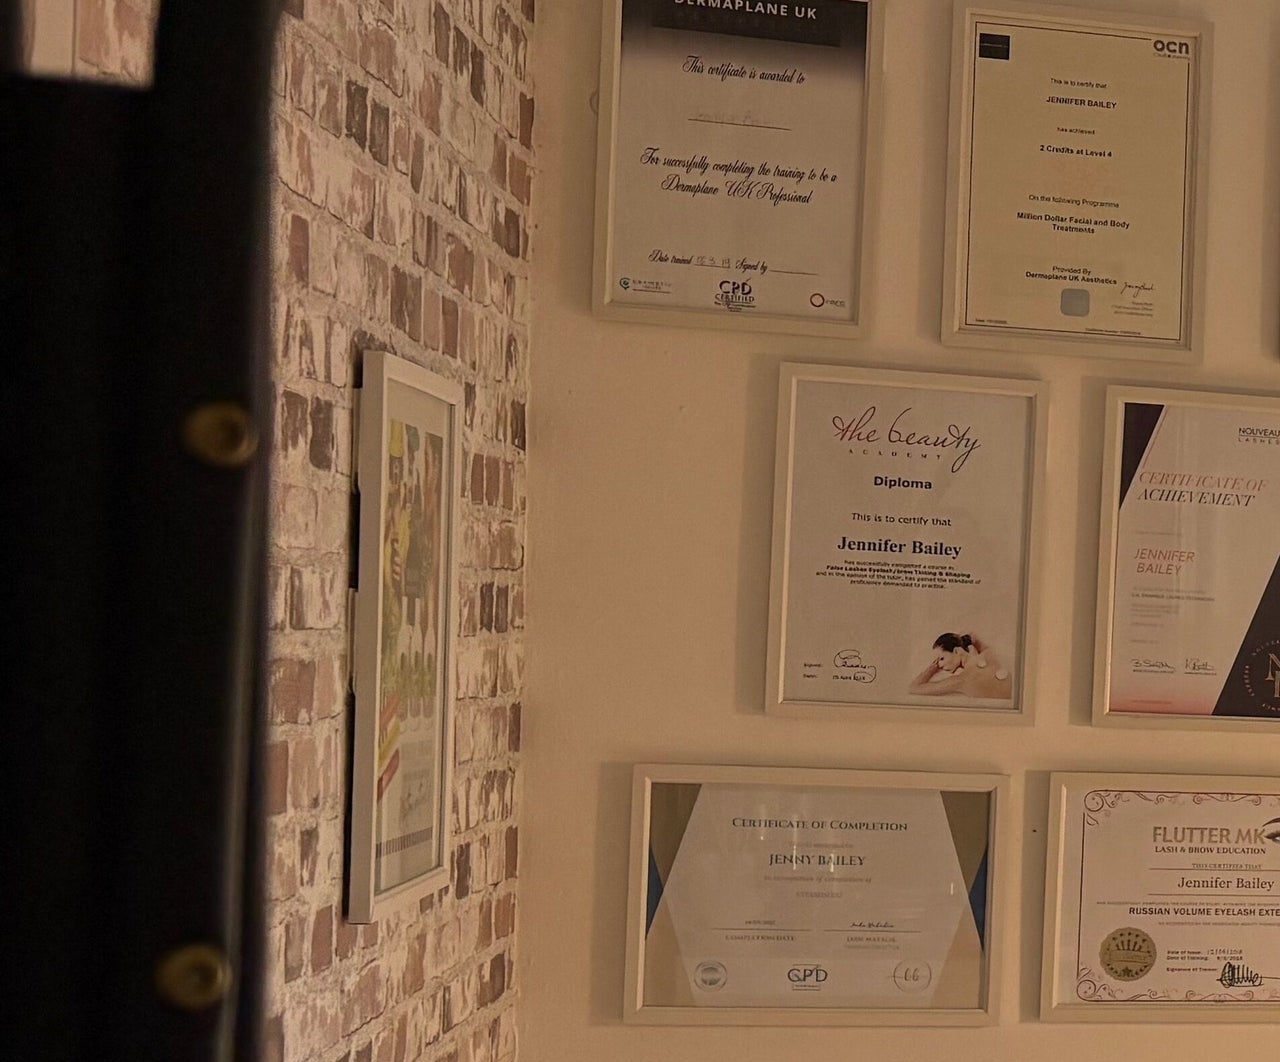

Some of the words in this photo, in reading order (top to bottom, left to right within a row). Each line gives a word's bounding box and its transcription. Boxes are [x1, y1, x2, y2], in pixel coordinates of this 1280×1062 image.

[675, 0, 788, 16] RMAPLANE
[795, 6, 816, 19] UK
[1153, 39, 1189, 54] ocn
[682, 55, 704, 75] This
[708, 63, 746, 85] certificate
[749, 68, 756, 79] is
[759, 68, 793, 83] awarded
[796, 72, 805, 84] to
[1046, 96, 1085, 107] JENNIFER
[1087, 100, 1116, 109] BAILEY
[1047, 145, 1074, 155] Credits
[1086, 149, 1105, 158] Level
[640, 147, 659, 165] For
[663, 154, 709, 174] successfully
[712, 160, 755, 179] completing
[758, 162, 771, 177] the
[773, 164, 806, 184] training
[808, 168, 816, 180] to
[820, 168, 829, 181] be
[661, 174, 719, 196] Dermaplane
[725, 180, 758, 199] UK
[757, 186, 813, 206] Professional
[1082, 198, 1119, 208] Programme
[1017, 212, 1042, 221] Million
[1045, 214, 1067, 223] Dollar
[1070, 217, 1092, 225] Facial
[1110, 220, 1130, 229] Body
[1052, 224, 1095, 234] Treatments
[649, 249, 669, 263] Date
[1026, 271, 1067, 281] Dermaplane
[719, 278, 752, 295] CPD
[832, 406, 880, 443] the
[888, 407, 981, 473] beauty
[874, 476, 932, 490] Diploma
[1139, 471, 1242, 489] CERTIFICATE
[1246, 479, 1270, 491] OF
[1137, 488, 1255, 507] ACHIEVEMENT
[852, 512, 871, 522] This
[886, 515, 895, 523] to
[898, 515, 928, 527] certify
[932, 517, 951, 527] that
[838, 536, 906, 554] Jennifer
[912, 540, 961, 560] Bailey
[1135, 549, 1195, 562] JENNIFER
[1137, 563, 1181, 576] BAILEY
[732, 817, 809, 830] CERTIFICATE
[812, 820, 827, 830] OF
[830, 820, 908, 832] COMPLETION
[1153, 826, 1231, 844] FLUTTER
[1235, 827, 1266, 845] MK
[1155, 846, 1177, 854] LASH
[1180, 846, 1186, 854] &
[1188, 846, 1214, 854] BROW
[1216, 847, 1266, 855] EDUCATION
[769, 854, 814, 866] JENNY
[818, 855, 865, 866] BAILEY
[1178, 877, 1232, 888] Jennifer
[1237, 878, 1274, 891] Bailey
[1129, 907, 1170, 916] RUSSIAN
[1174, 908, 1211, 917] VOLUME
[1215, 908, 1256, 917] EYELASH
